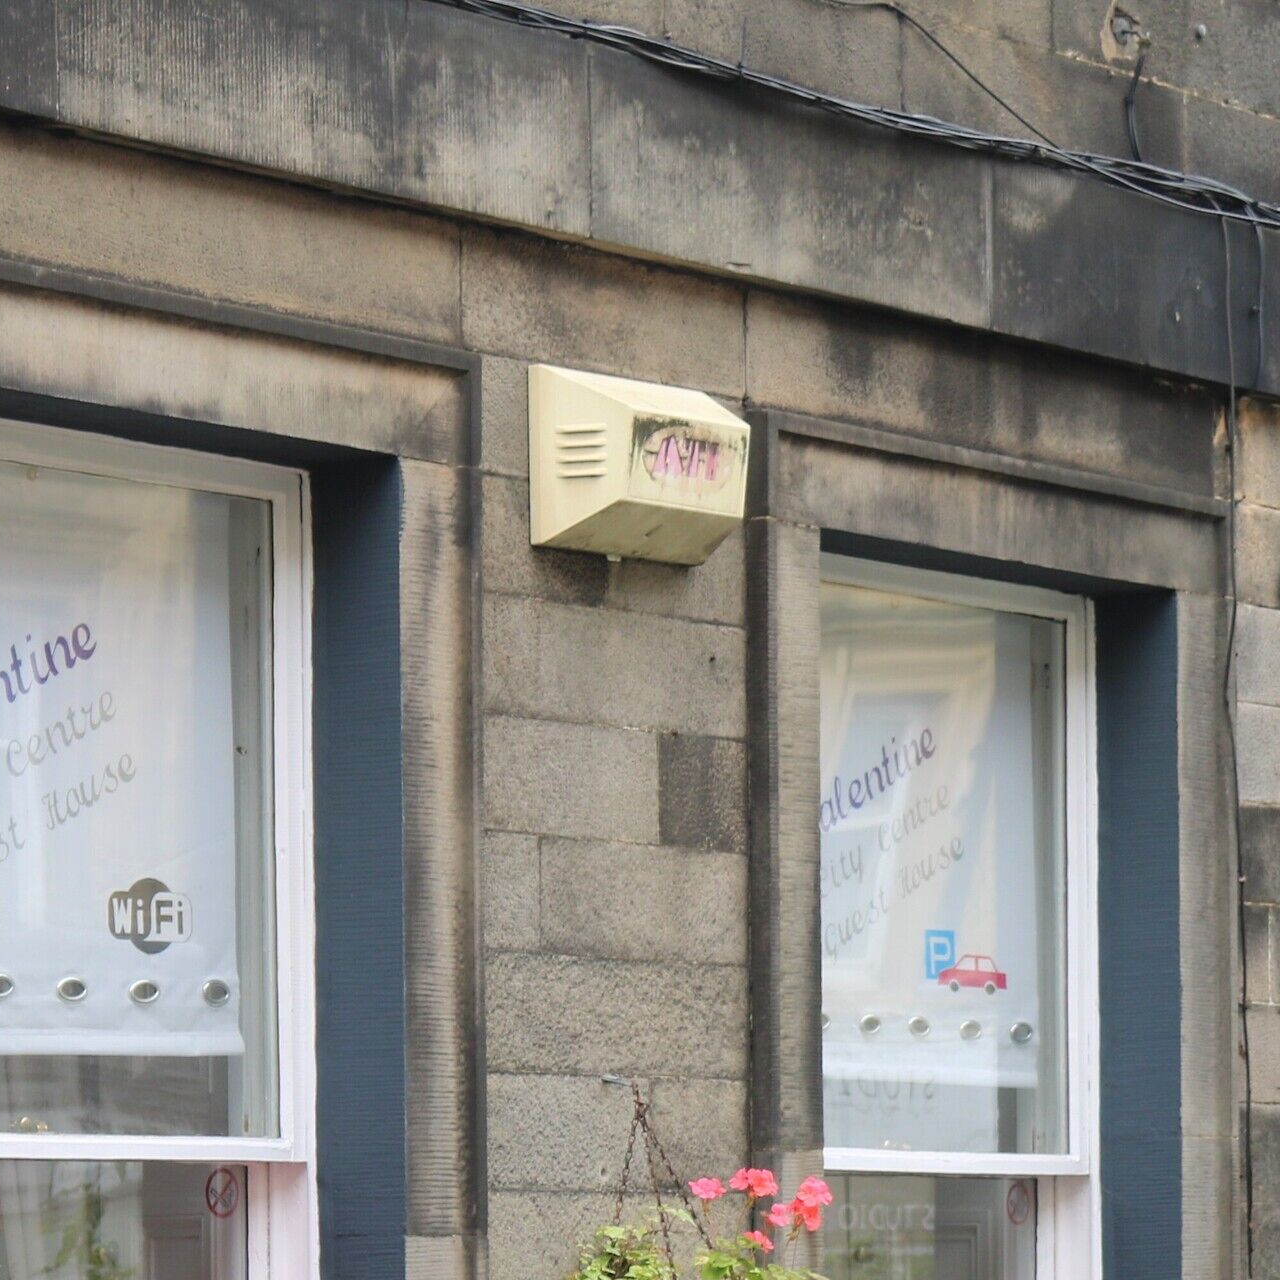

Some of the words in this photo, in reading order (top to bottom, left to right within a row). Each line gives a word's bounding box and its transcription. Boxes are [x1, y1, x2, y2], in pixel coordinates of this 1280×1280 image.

[6, 691, 117, 777] Centre
[41, 753, 136, 830] House
[819, 728, 937, 833] alentine
[878, 784, 951, 851] Centre
[111, 897, 184, 935] WiFi
